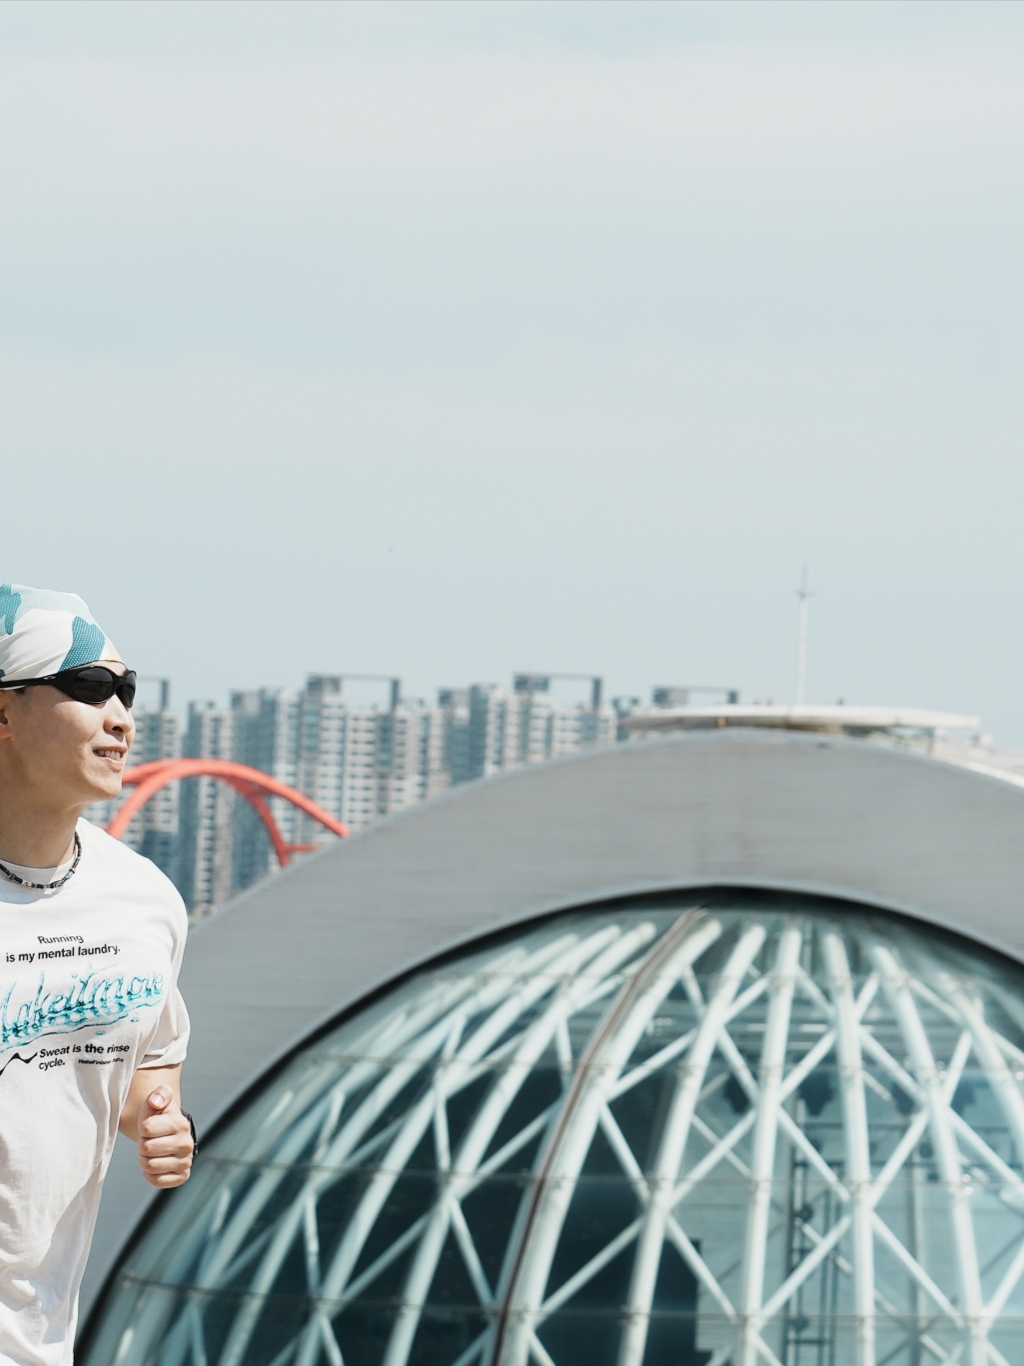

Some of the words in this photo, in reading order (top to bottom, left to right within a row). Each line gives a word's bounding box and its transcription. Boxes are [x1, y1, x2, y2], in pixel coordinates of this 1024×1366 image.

[37, 934, 84, 945] Running
[5, 952, 15, 963] is
[18, 952, 35, 963] my
[38, 947, 75, 960] mental
[78, 943, 121, 956] laundry.
[39, 1045, 71, 1058] Sweat
[72, 1044, 82, 1053] is
[85, 1043, 105, 1054] the
[107, 1044, 130, 1054] rinse
[38, 1057, 66, 1072] cycle.
